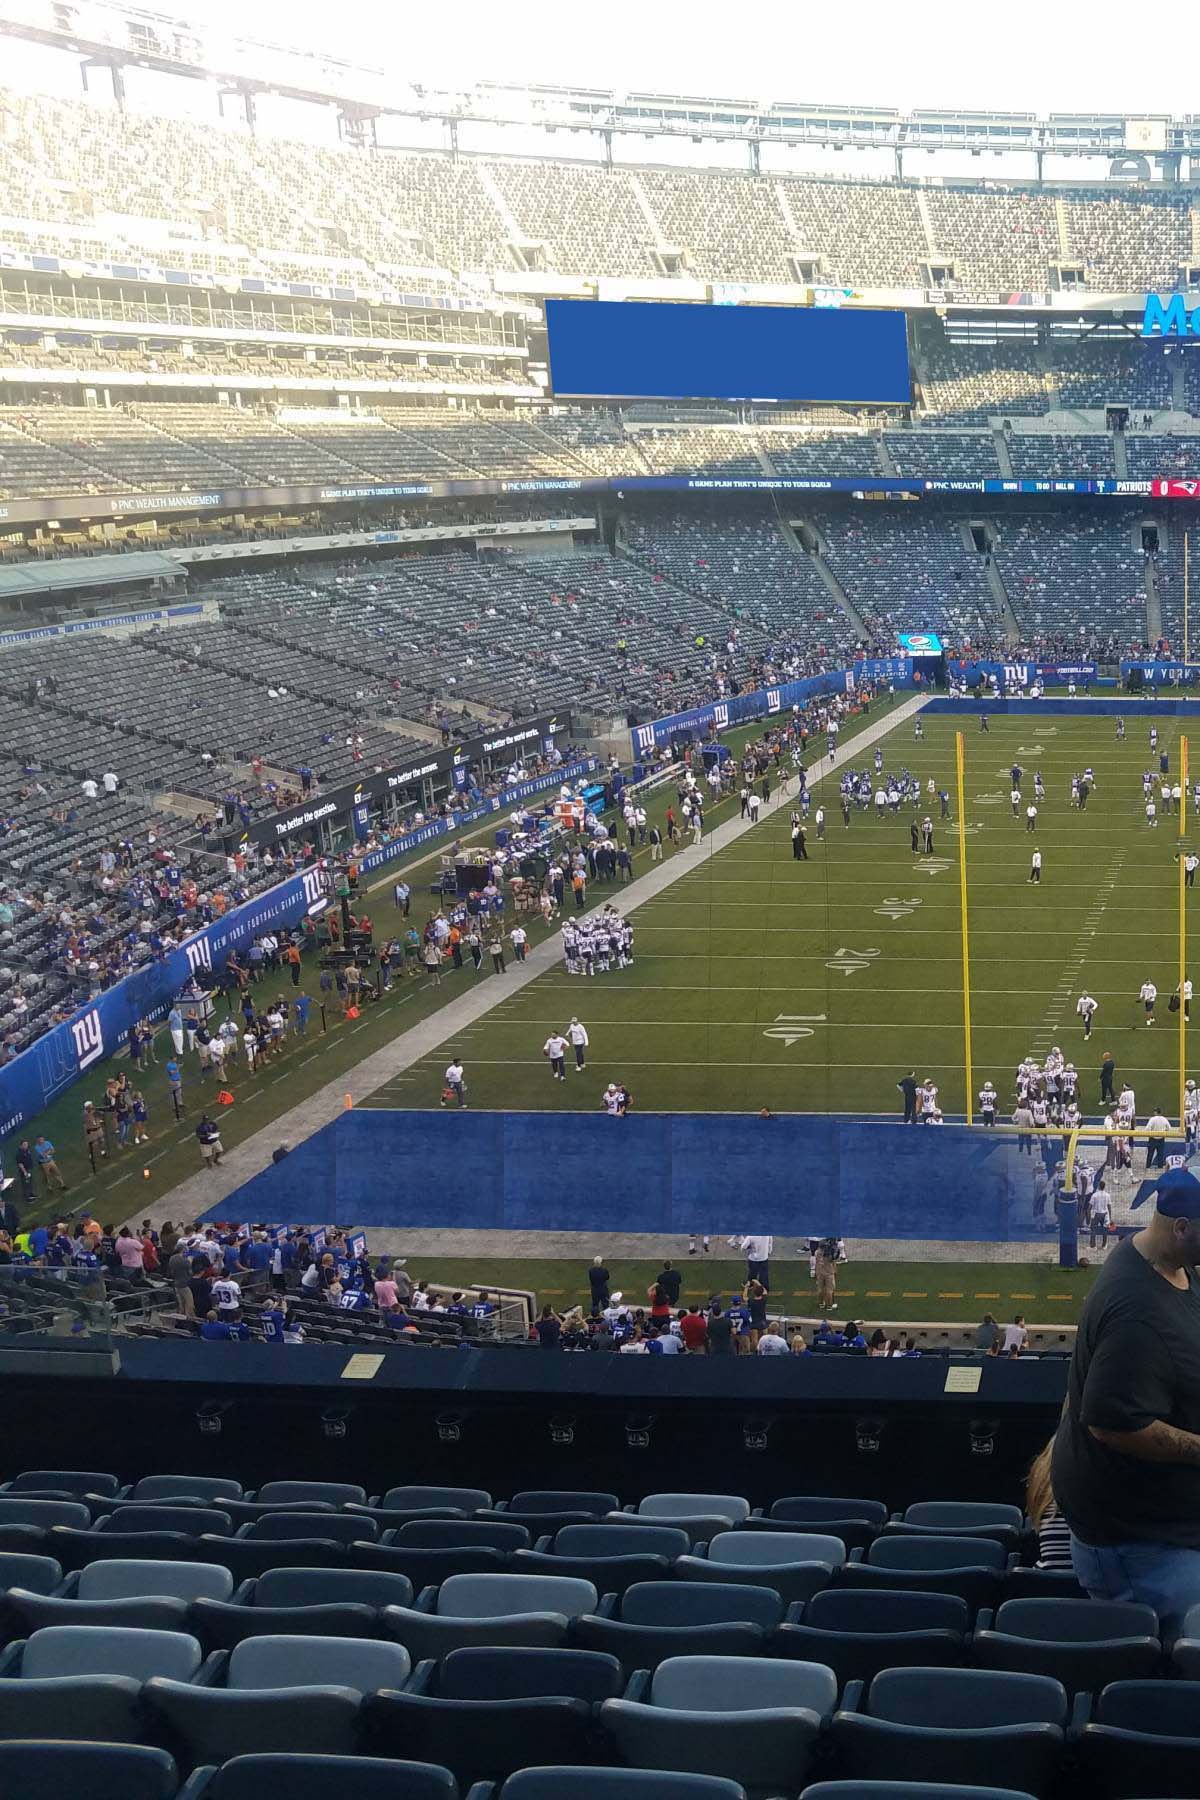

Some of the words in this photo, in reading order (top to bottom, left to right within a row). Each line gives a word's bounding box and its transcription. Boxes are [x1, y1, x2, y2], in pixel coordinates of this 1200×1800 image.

[508, 482, 520, 491] PNC
[521, 481, 543, 490] WEALTH
[544, 480, 582, 489] MANAGEMENT
[933, 481, 950, 490] PNC
[951, 481, 981, 490] WEALTH
[1116, 481, 1151, 491] PATRIOTS
[1160, 481, 1168, 495] 0
[119, 499, 135, 510] PNC
[136, 498, 166, 509] WEALTH
[168, 495, 220, 507] MANAGEMENT
[1161, 668, 1191, 680] YORK
[483, 742, 492, 752] The
[492, 738, 506, 750] better
[506, 735, 514, 745] the
[387, 777, 397, 787] The
[397, 770, 413, 783] better
[412, 766, 421, 778] the
[506, 790, 517, 802] NEW
[519, 785, 534, 797] YORK
[536, 774, 562, 792] FOOTBALL
[276, 823, 287, 834] The
[287, 815, 304, 831] better
[304, 811, 314, 822] the
[367, 855, 384, 868] YORK
[386, 836, 415, 858] FOOTBALL
[417, 825, 440, 843] GIANTS
[873, 897, 923, 915] 30
[213, 935, 226, 952] NEW
[230, 925, 245, 942] YORK
[248, 906, 280, 930] FOOTBALL
[281, 890, 304, 910] GIANTS
[824, 947, 881, 970] 20
[763, 1012, 828, 1039] 10
[219, 1290, 232, 1304] 13
[341, 1295, 358, 1310] 97
